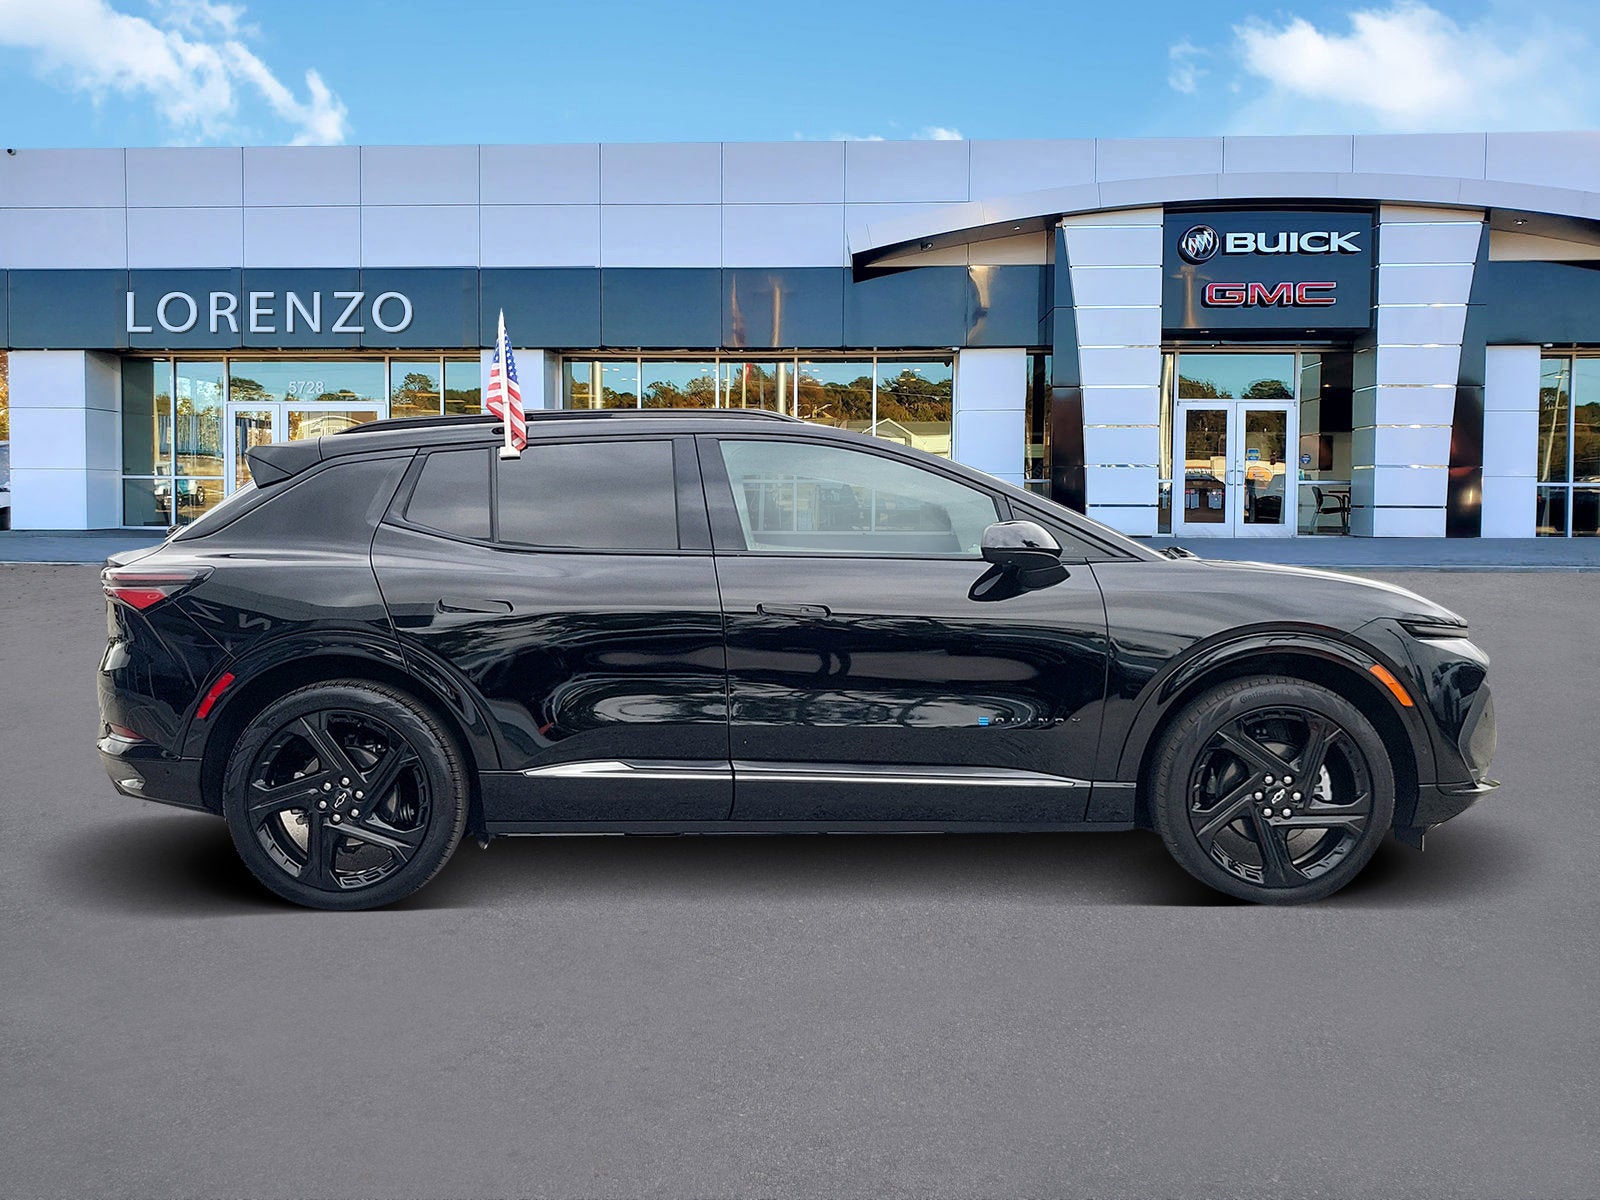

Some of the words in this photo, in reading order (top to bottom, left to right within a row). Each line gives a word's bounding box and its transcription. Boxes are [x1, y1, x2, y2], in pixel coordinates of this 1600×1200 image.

[1226, 231, 1361, 253] BUICK
[1207, 282, 1337, 305] GMC
[126, 291, 413, 333] LORENZO
[288, 381, 325, 394] 5728
